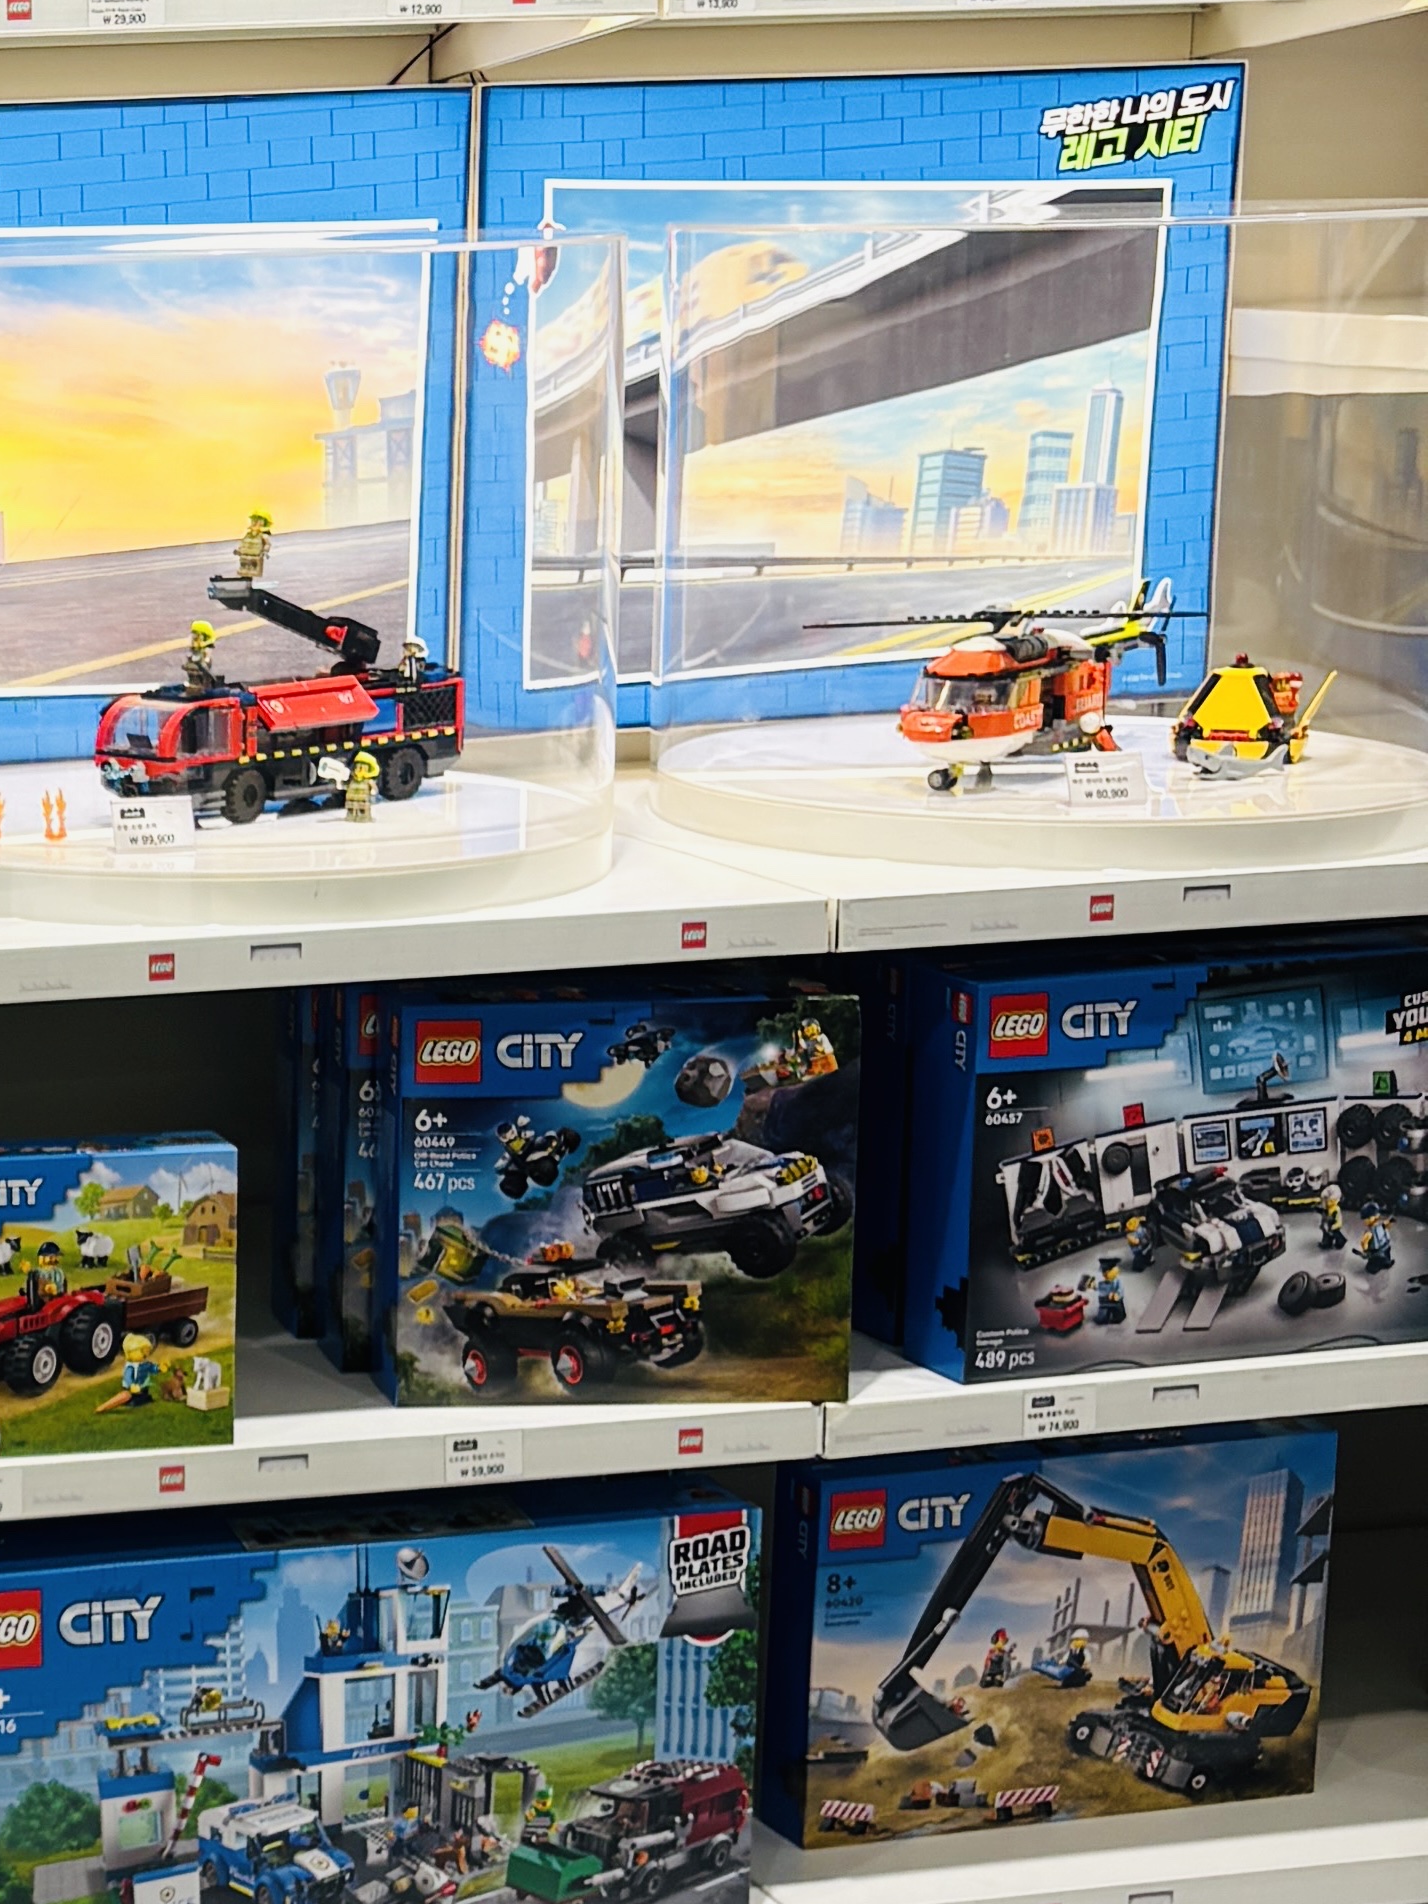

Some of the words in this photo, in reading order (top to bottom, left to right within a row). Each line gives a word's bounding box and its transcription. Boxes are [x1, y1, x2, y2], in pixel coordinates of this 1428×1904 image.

[1040, 99, 1120, 138] 무한한
[1121, 89, 1176, 125] 나의
[1177, 79, 1236, 116] 도시
[1058, 127, 1128, 171] 레고
[1134, 114, 1207, 159] 시티
[1013, 711, 1042, 730] COAST
[417, 1038, 479, 1066] LEGO
[496, 1032, 582, 1069] CITY
[415, 1110, 448, 1131] 6+
[985, 1113, 1022, 1126] 60457
[414, 1135, 455, 1148] 60449
[414, 1173, 445, 1190] 467
[448, 1174, 475, 1193] pcs
[975, 1350, 1005, 1369] 489
[1008, 1349, 1035, 1370] pcs
[831, 1505, 885, 1533] LEGO
[897, 1493, 971, 1531] CITY
[674, 1530, 746, 1565] ROAD
[676, 1552, 744, 1580] PLATES
[679, 1571, 737, 1590] INCLUDED
[827, 1573, 856, 1594] 8+
[58, 1595, 164, 1647] CITY
